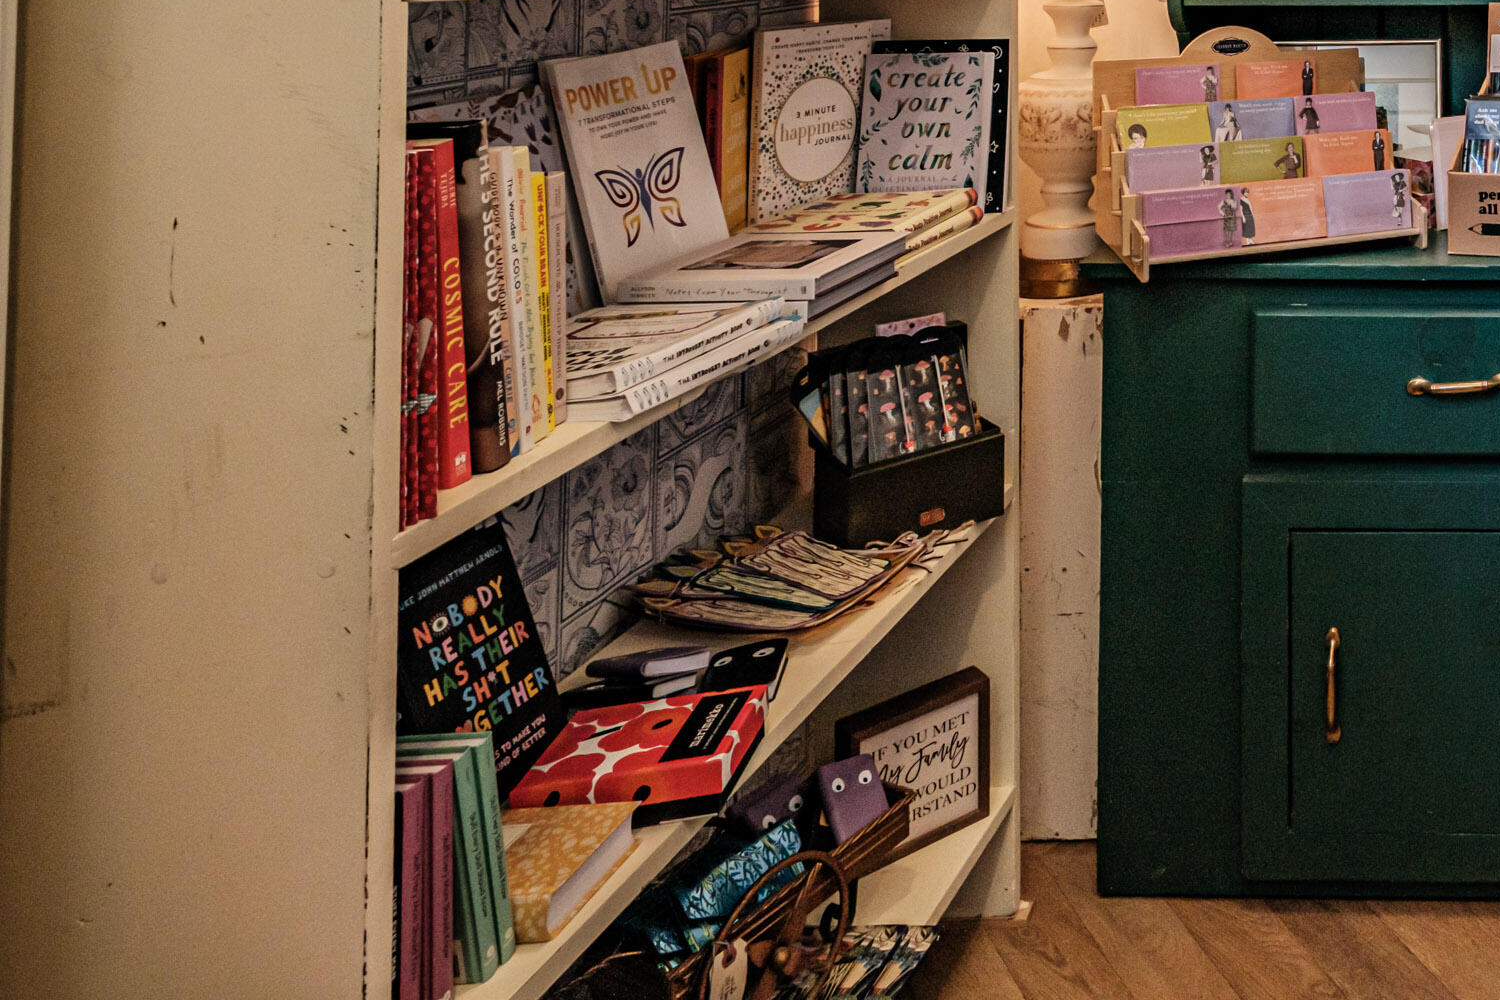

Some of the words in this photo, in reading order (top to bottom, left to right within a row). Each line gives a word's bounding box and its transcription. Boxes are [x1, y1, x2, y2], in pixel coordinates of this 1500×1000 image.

[565, 76, 639, 115] POWER
[640, 63, 677, 96] UP
[887, 64, 966, 89] create
[583, 104, 651, 126] TRANSFORMATIONAL
[652, 96, 676, 109] STEPS
[804, 104, 837, 118] MINUTE
[888, 96, 953, 121] your
[780, 117, 853, 146] happiness
[814, 134, 851, 147] JOURNAL
[901, 121, 952, 139] own
[478, 144, 490, 186] THE
[888, 145, 953, 171] calm
[506, 179, 514, 198] The
[509, 201, 518, 241] Wonder
[1479, 204, 1498, 215] all
[482, 207, 499, 303] SECOND
[490, 172, 502, 230] GUIDEBOOK
[497, 257, 509, 322] UNKNOWN
[539, 229, 548, 258] YOUR
[512, 258, 524, 305] COLORS
[541, 259, 549, 288] BRAIN
[443, 256, 466, 352] COSMIC
[488, 304, 504, 367] RULE
[705, 332, 729, 349] ACTIVITY
[722, 353, 747, 371] ACTIVITY
[447, 362, 468, 430] CARE
[497, 397, 507, 447] ROBBINS
[417, 583, 438, 601] JOHN
[438, 562, 475, 588] MATTHEW
[475, 544, 503, 566] ARNOLD
[412, 575, 503, 650] NOBODY
[429, 604, 505, 671] REALLY
[423, 660, 469, 707] HAS
[471, 620, 530, 672] THEIR
[501, 741, 512, 752] TO
[512, 726, 531, 746] MAKE
[531, 713, 546, 731] YOU
[512, 746, 521, 759] OF
[521, 727, 547, 752] BETTER
[689, 702, 725, 749] marimekko
[871, 745, 889, 763] IF
[892, 729, 928, 757] YOU
[933, 711, 971, 735] MET
[905, 731, 970, 785] Family
[913, 765, 972, 801] WOULD
